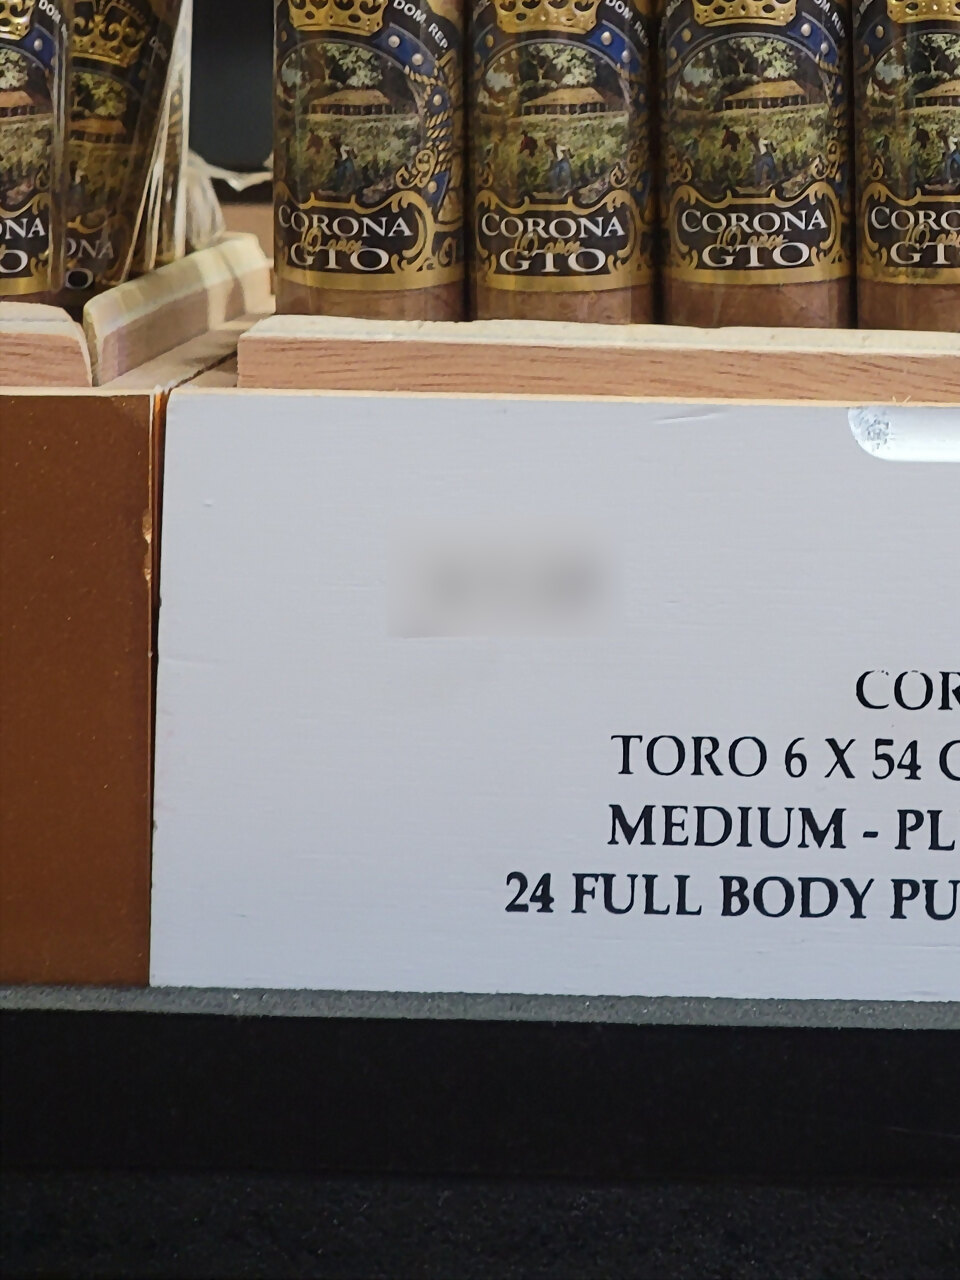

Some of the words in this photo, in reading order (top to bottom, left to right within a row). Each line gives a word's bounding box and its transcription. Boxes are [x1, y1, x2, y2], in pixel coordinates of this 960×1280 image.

[279, 205, 414, 238] CORONA
[481, 211, 626, 240] CORONA
[681, 208, 829, 234] CORONA
[290, 246, 391, 272] GTO
[499, 246, 607, 273] GTO
[701, 241, 811, 268] GTO
[610, 734, 768, 778] TORO
[784, 737, 808, 778] 6
[824, 737, 856, 779] X
[872, 738, 922, 781] 54
[607, 803, 847, 850] MEDIUM
[504, 871, 555, 914] 24
[570, 872, 703, 916] FULL
[719, 875, 875, 919] BODY
